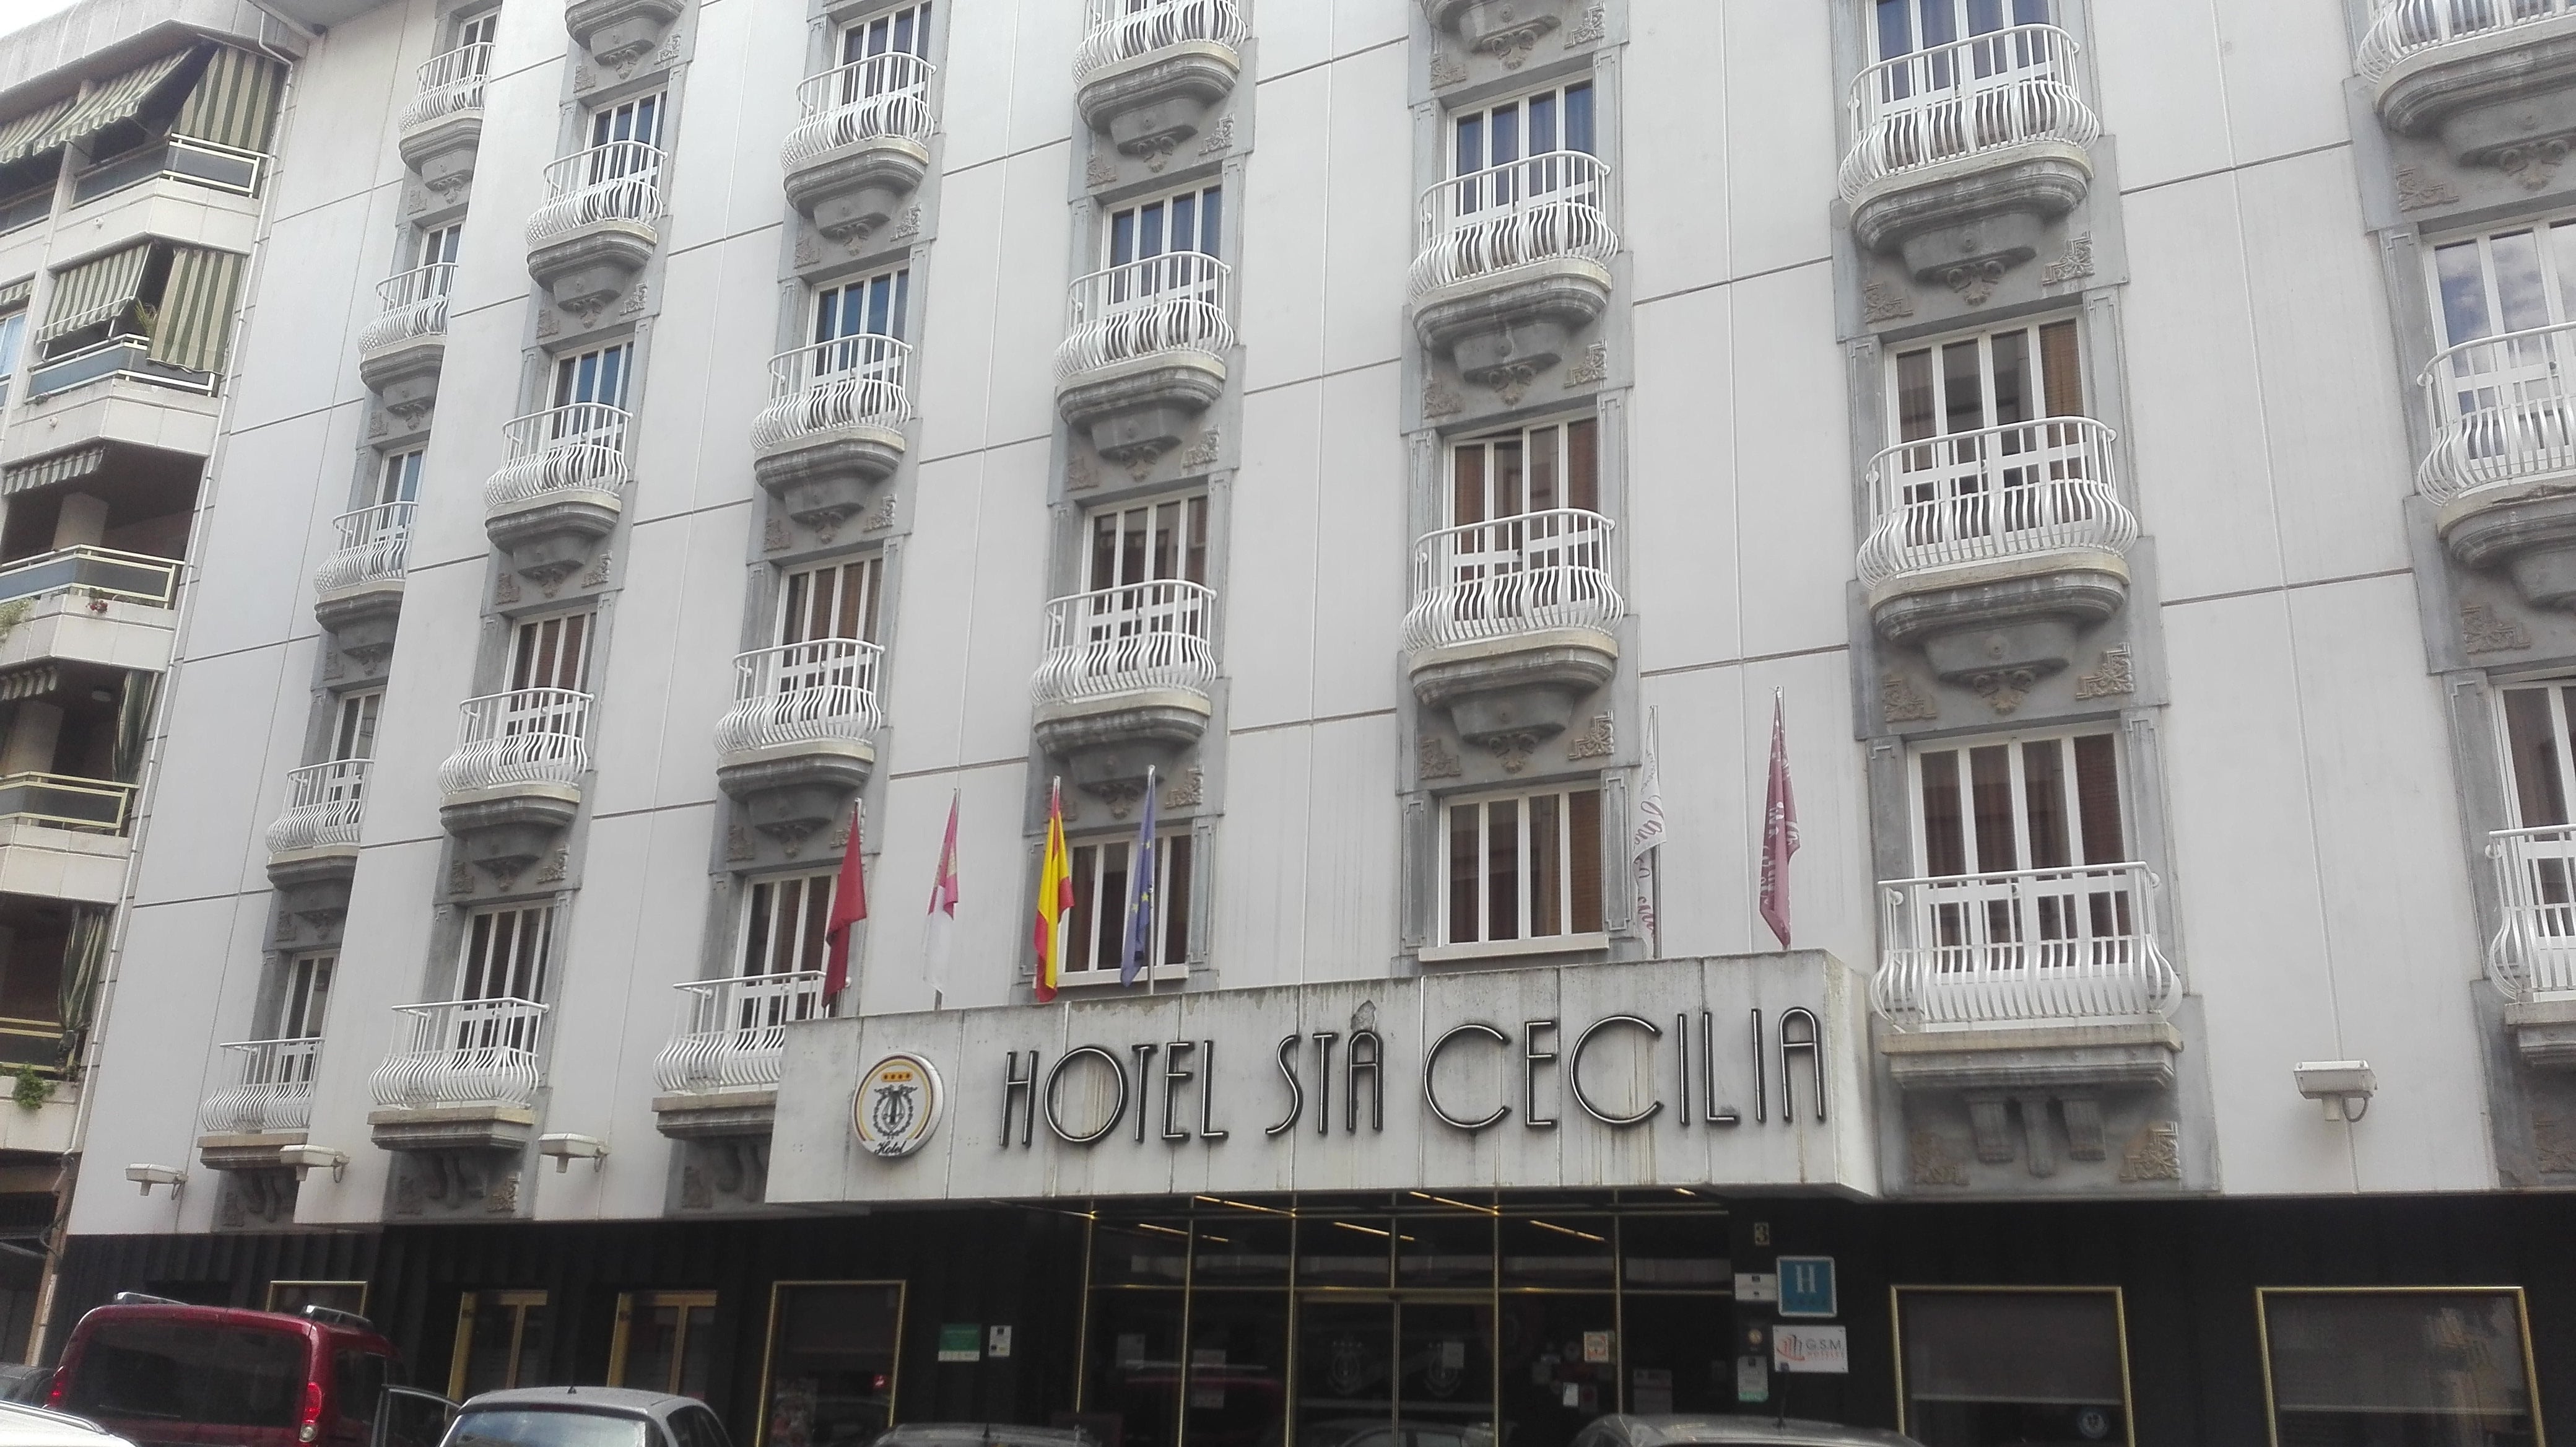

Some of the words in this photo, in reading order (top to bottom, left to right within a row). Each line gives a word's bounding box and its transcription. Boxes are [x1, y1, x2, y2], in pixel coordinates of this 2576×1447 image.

[999, 1040, 1229, 1148] HOTEL
[1423, 1006, 1827, 1132] CECILIA
[874, 1139, 908, 1155] Hotel
